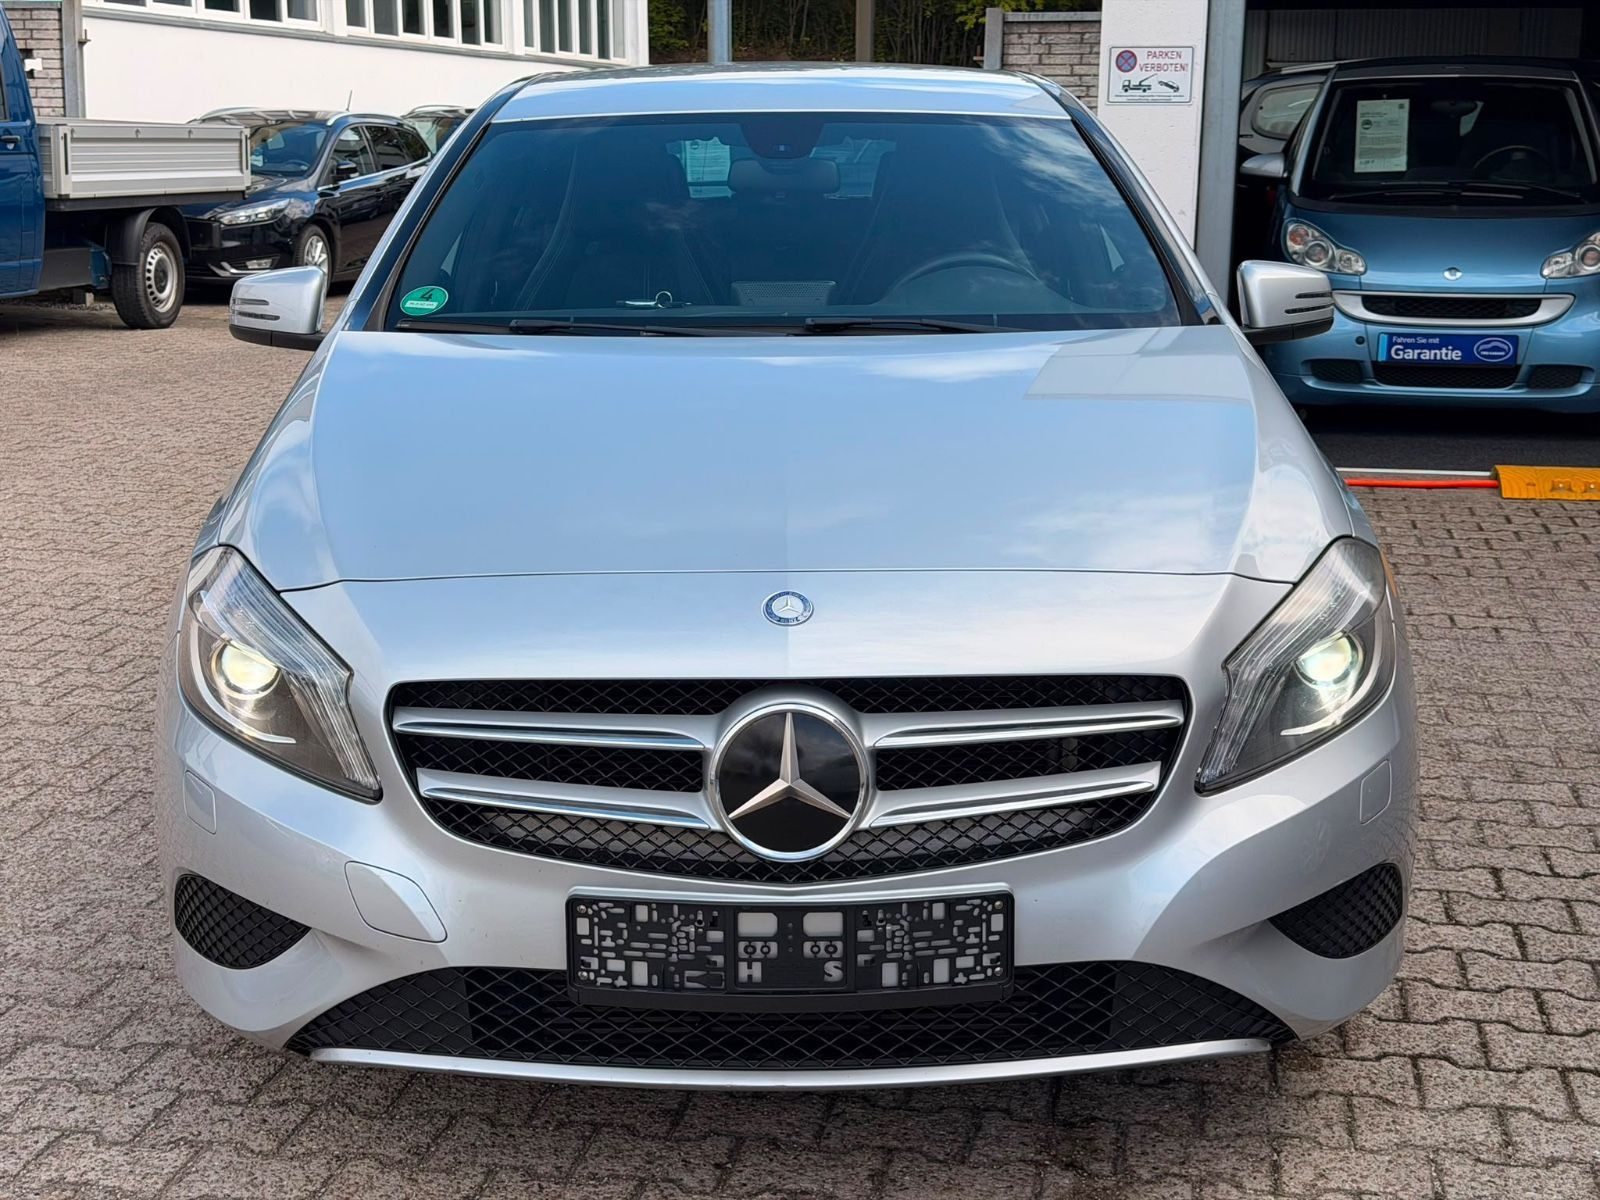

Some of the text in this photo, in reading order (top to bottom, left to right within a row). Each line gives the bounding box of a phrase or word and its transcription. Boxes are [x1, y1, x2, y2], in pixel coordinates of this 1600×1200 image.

[1146, 50, 1182, 60] PARKEN
[1139, 63, 1189, 72] VERBOTEN!
[420, 288, 435, 301] 4
[1392, 336, 1440, 344] Fahren Sie mit
[1390, 345, 1462, 361] Garantie
[738, 961, 844, 983] H S
